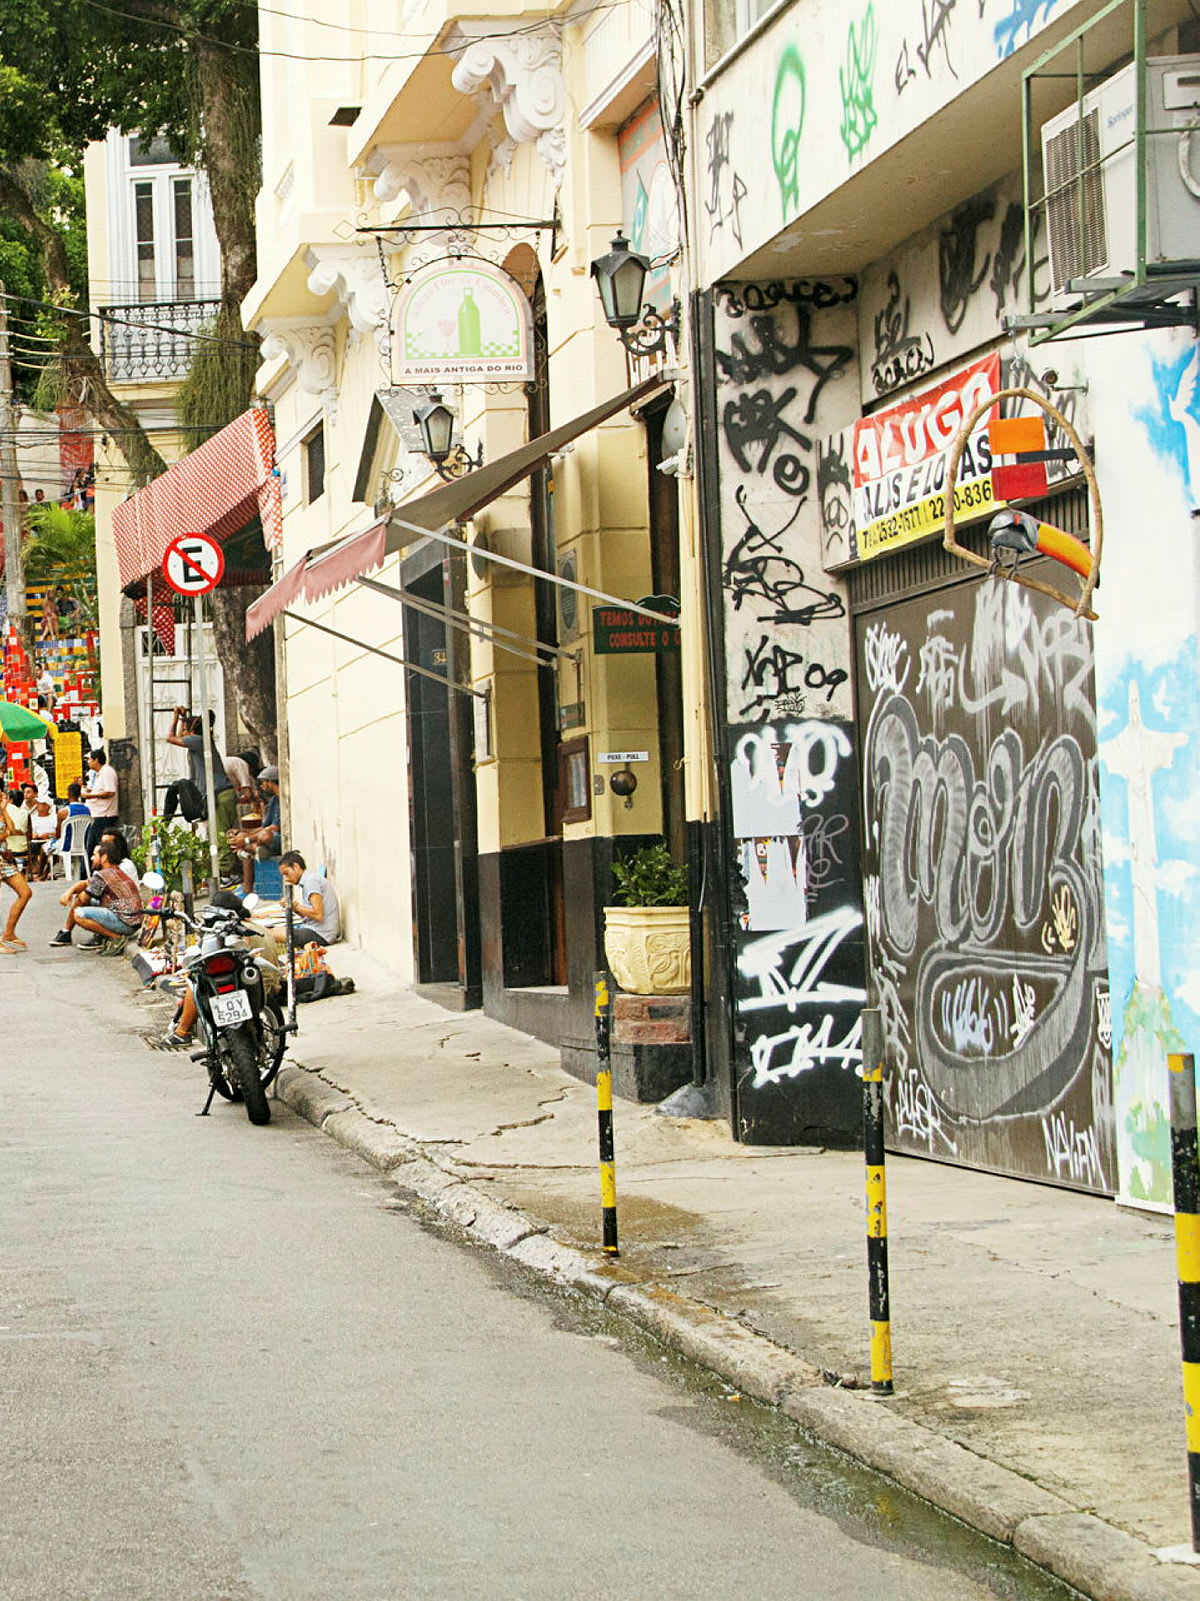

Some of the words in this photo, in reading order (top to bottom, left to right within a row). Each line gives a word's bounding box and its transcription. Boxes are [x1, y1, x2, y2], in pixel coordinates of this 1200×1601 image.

[415, 366, 440, 374] MAIS
[444, 365, 484, 373] ANTIGA
[857, 372, 993, 480] ALUGO
[906, 466, 923, 503] E
[923, 434, 993, 496] LOAS
[182, 544, 205, 583] E
[600, 611, 634, 627] TEMOS
